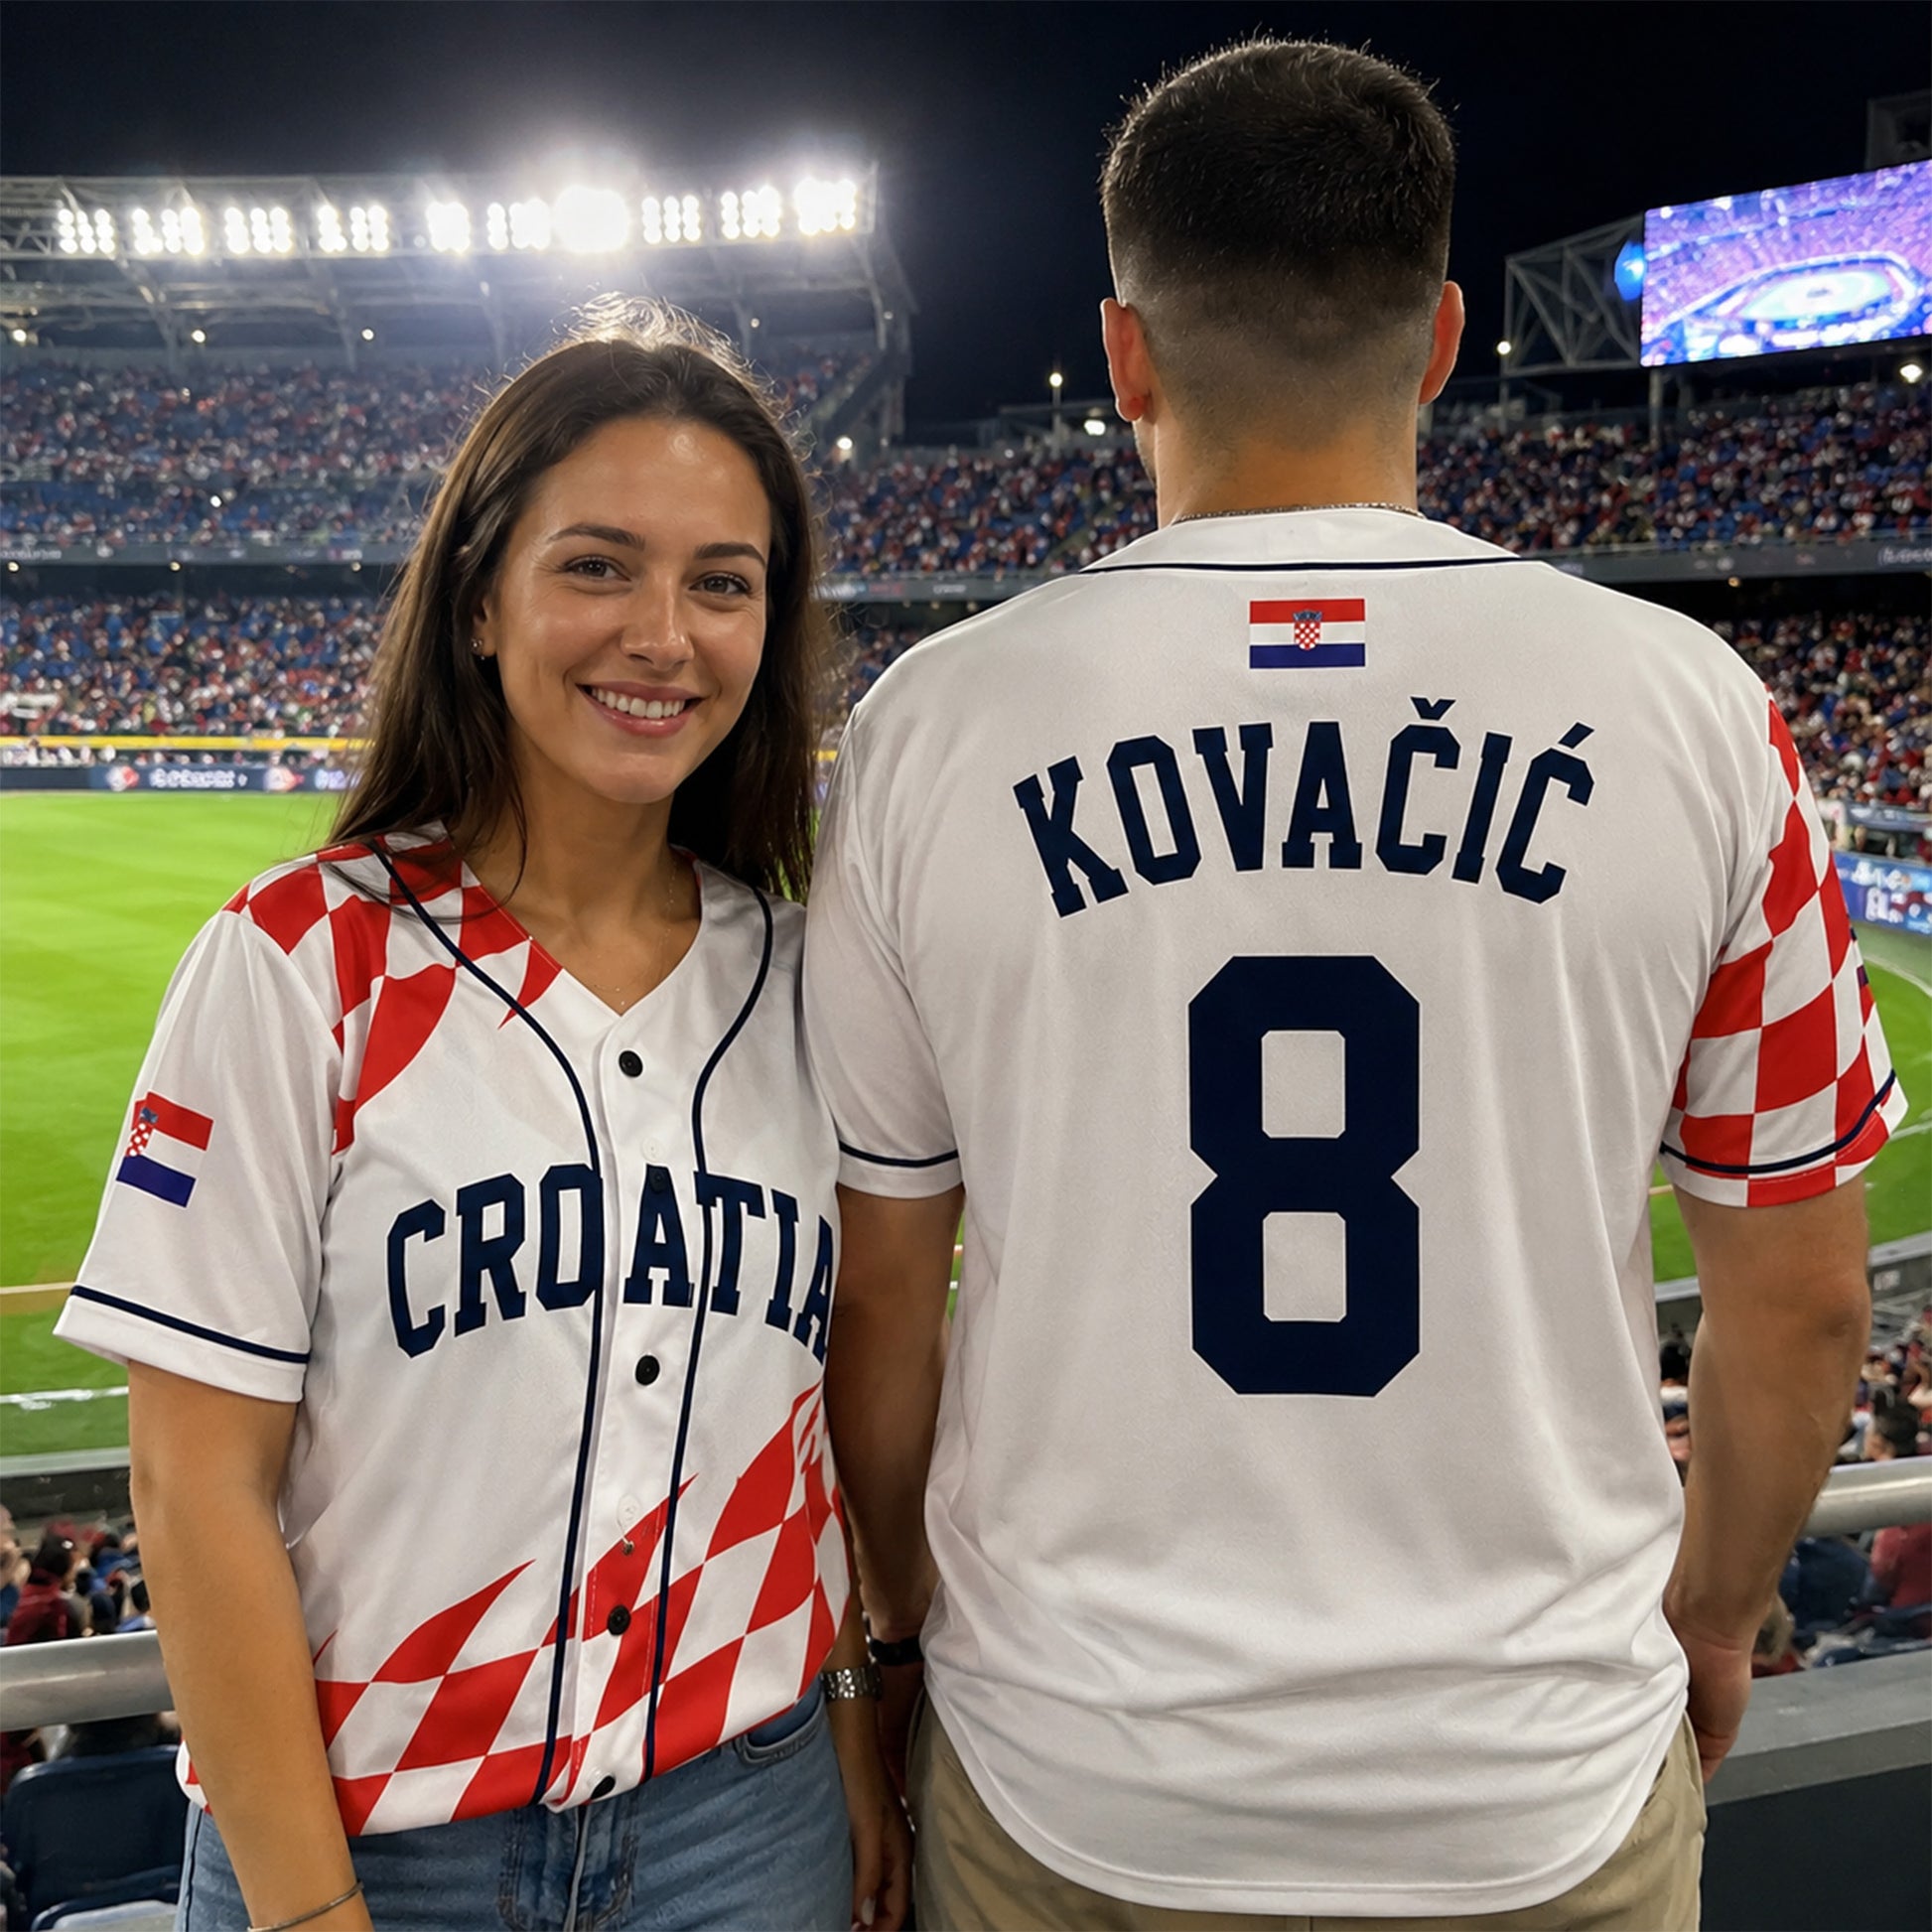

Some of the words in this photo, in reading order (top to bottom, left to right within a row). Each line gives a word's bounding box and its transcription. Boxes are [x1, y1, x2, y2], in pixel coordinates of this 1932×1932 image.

[1013, 697, 1595, 918] KOVAČIĆ
[387, 1164, 834, 1366] CROATIA
[1187, 955, 1421, 1398] 8
